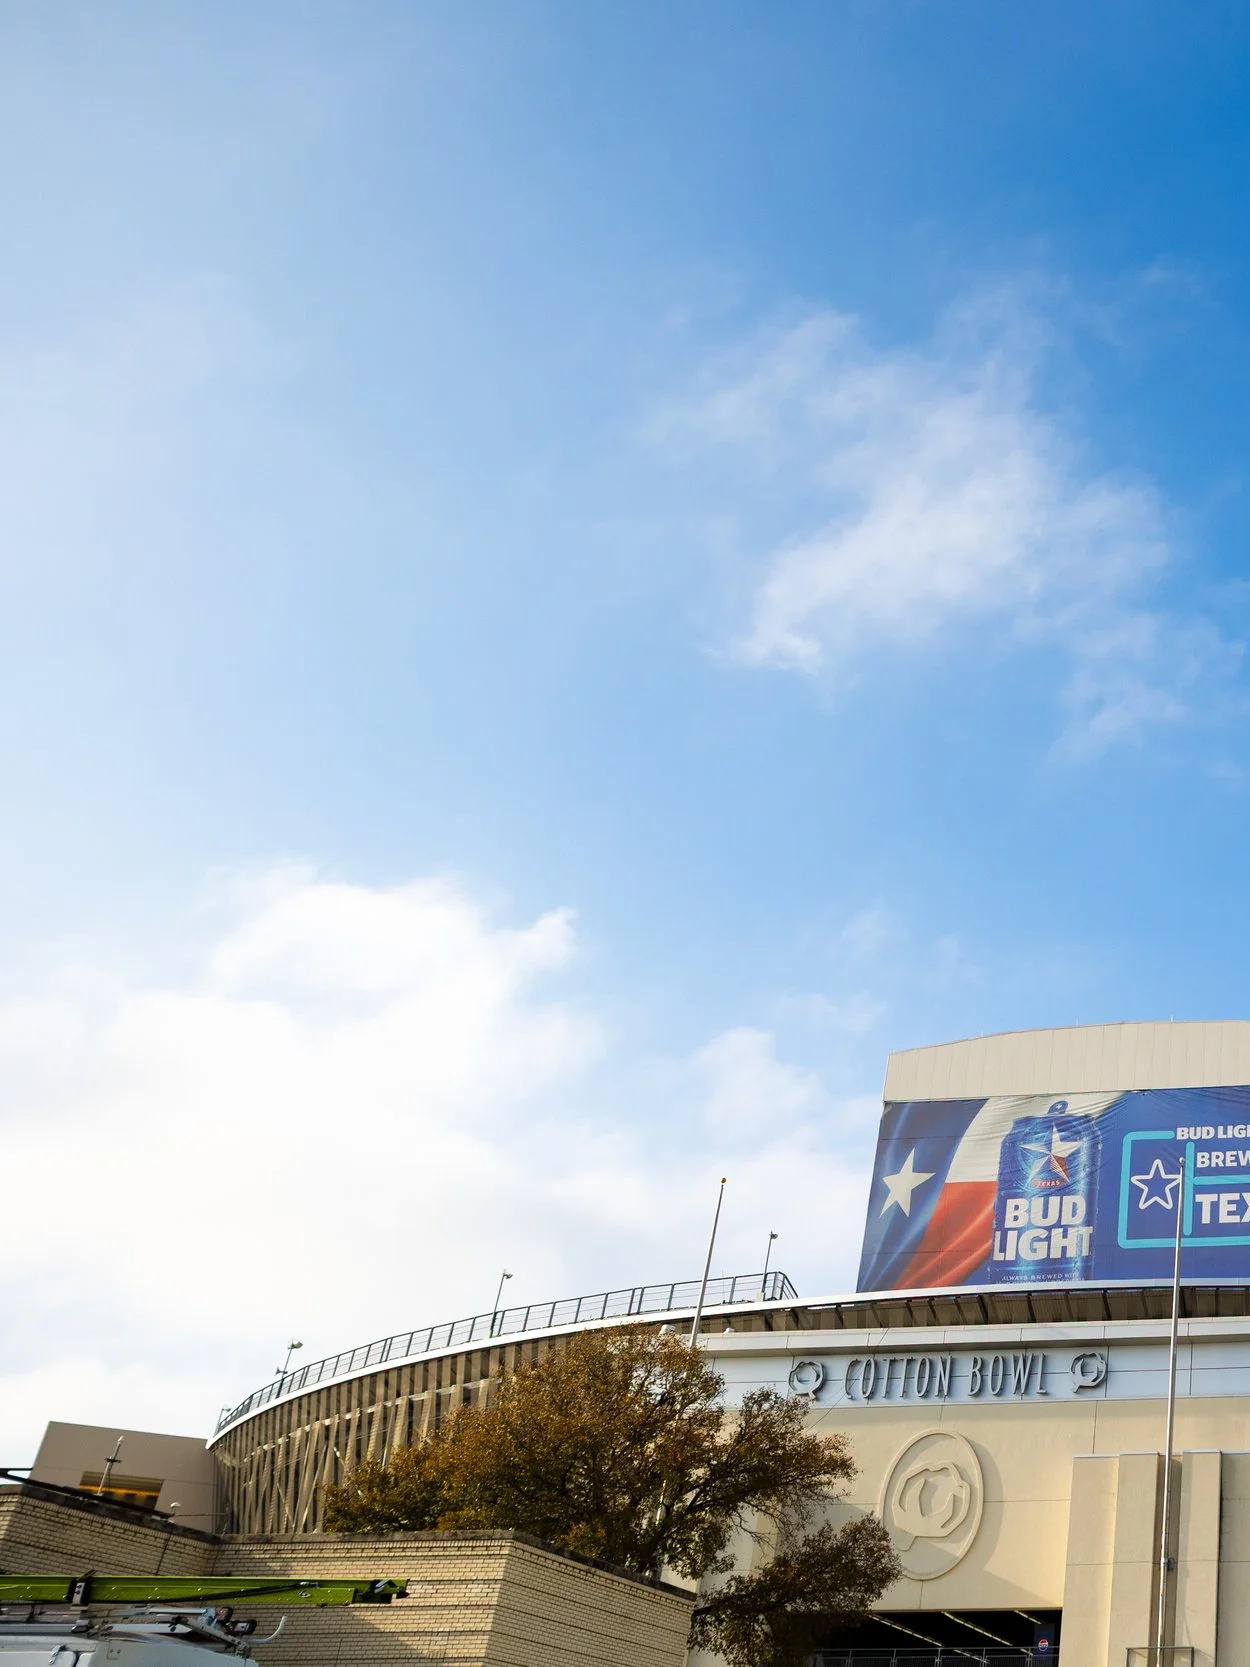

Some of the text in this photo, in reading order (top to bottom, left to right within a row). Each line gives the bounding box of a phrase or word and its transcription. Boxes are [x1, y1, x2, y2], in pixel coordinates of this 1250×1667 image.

[1176, 1126, 1215, 1140] BUD
[1004, 1195, 1086, 1228] BUD
[993, 1226, 1093, 1261] LIGHT
[844, 1352, 1048, 1399] COTTON BOWL
